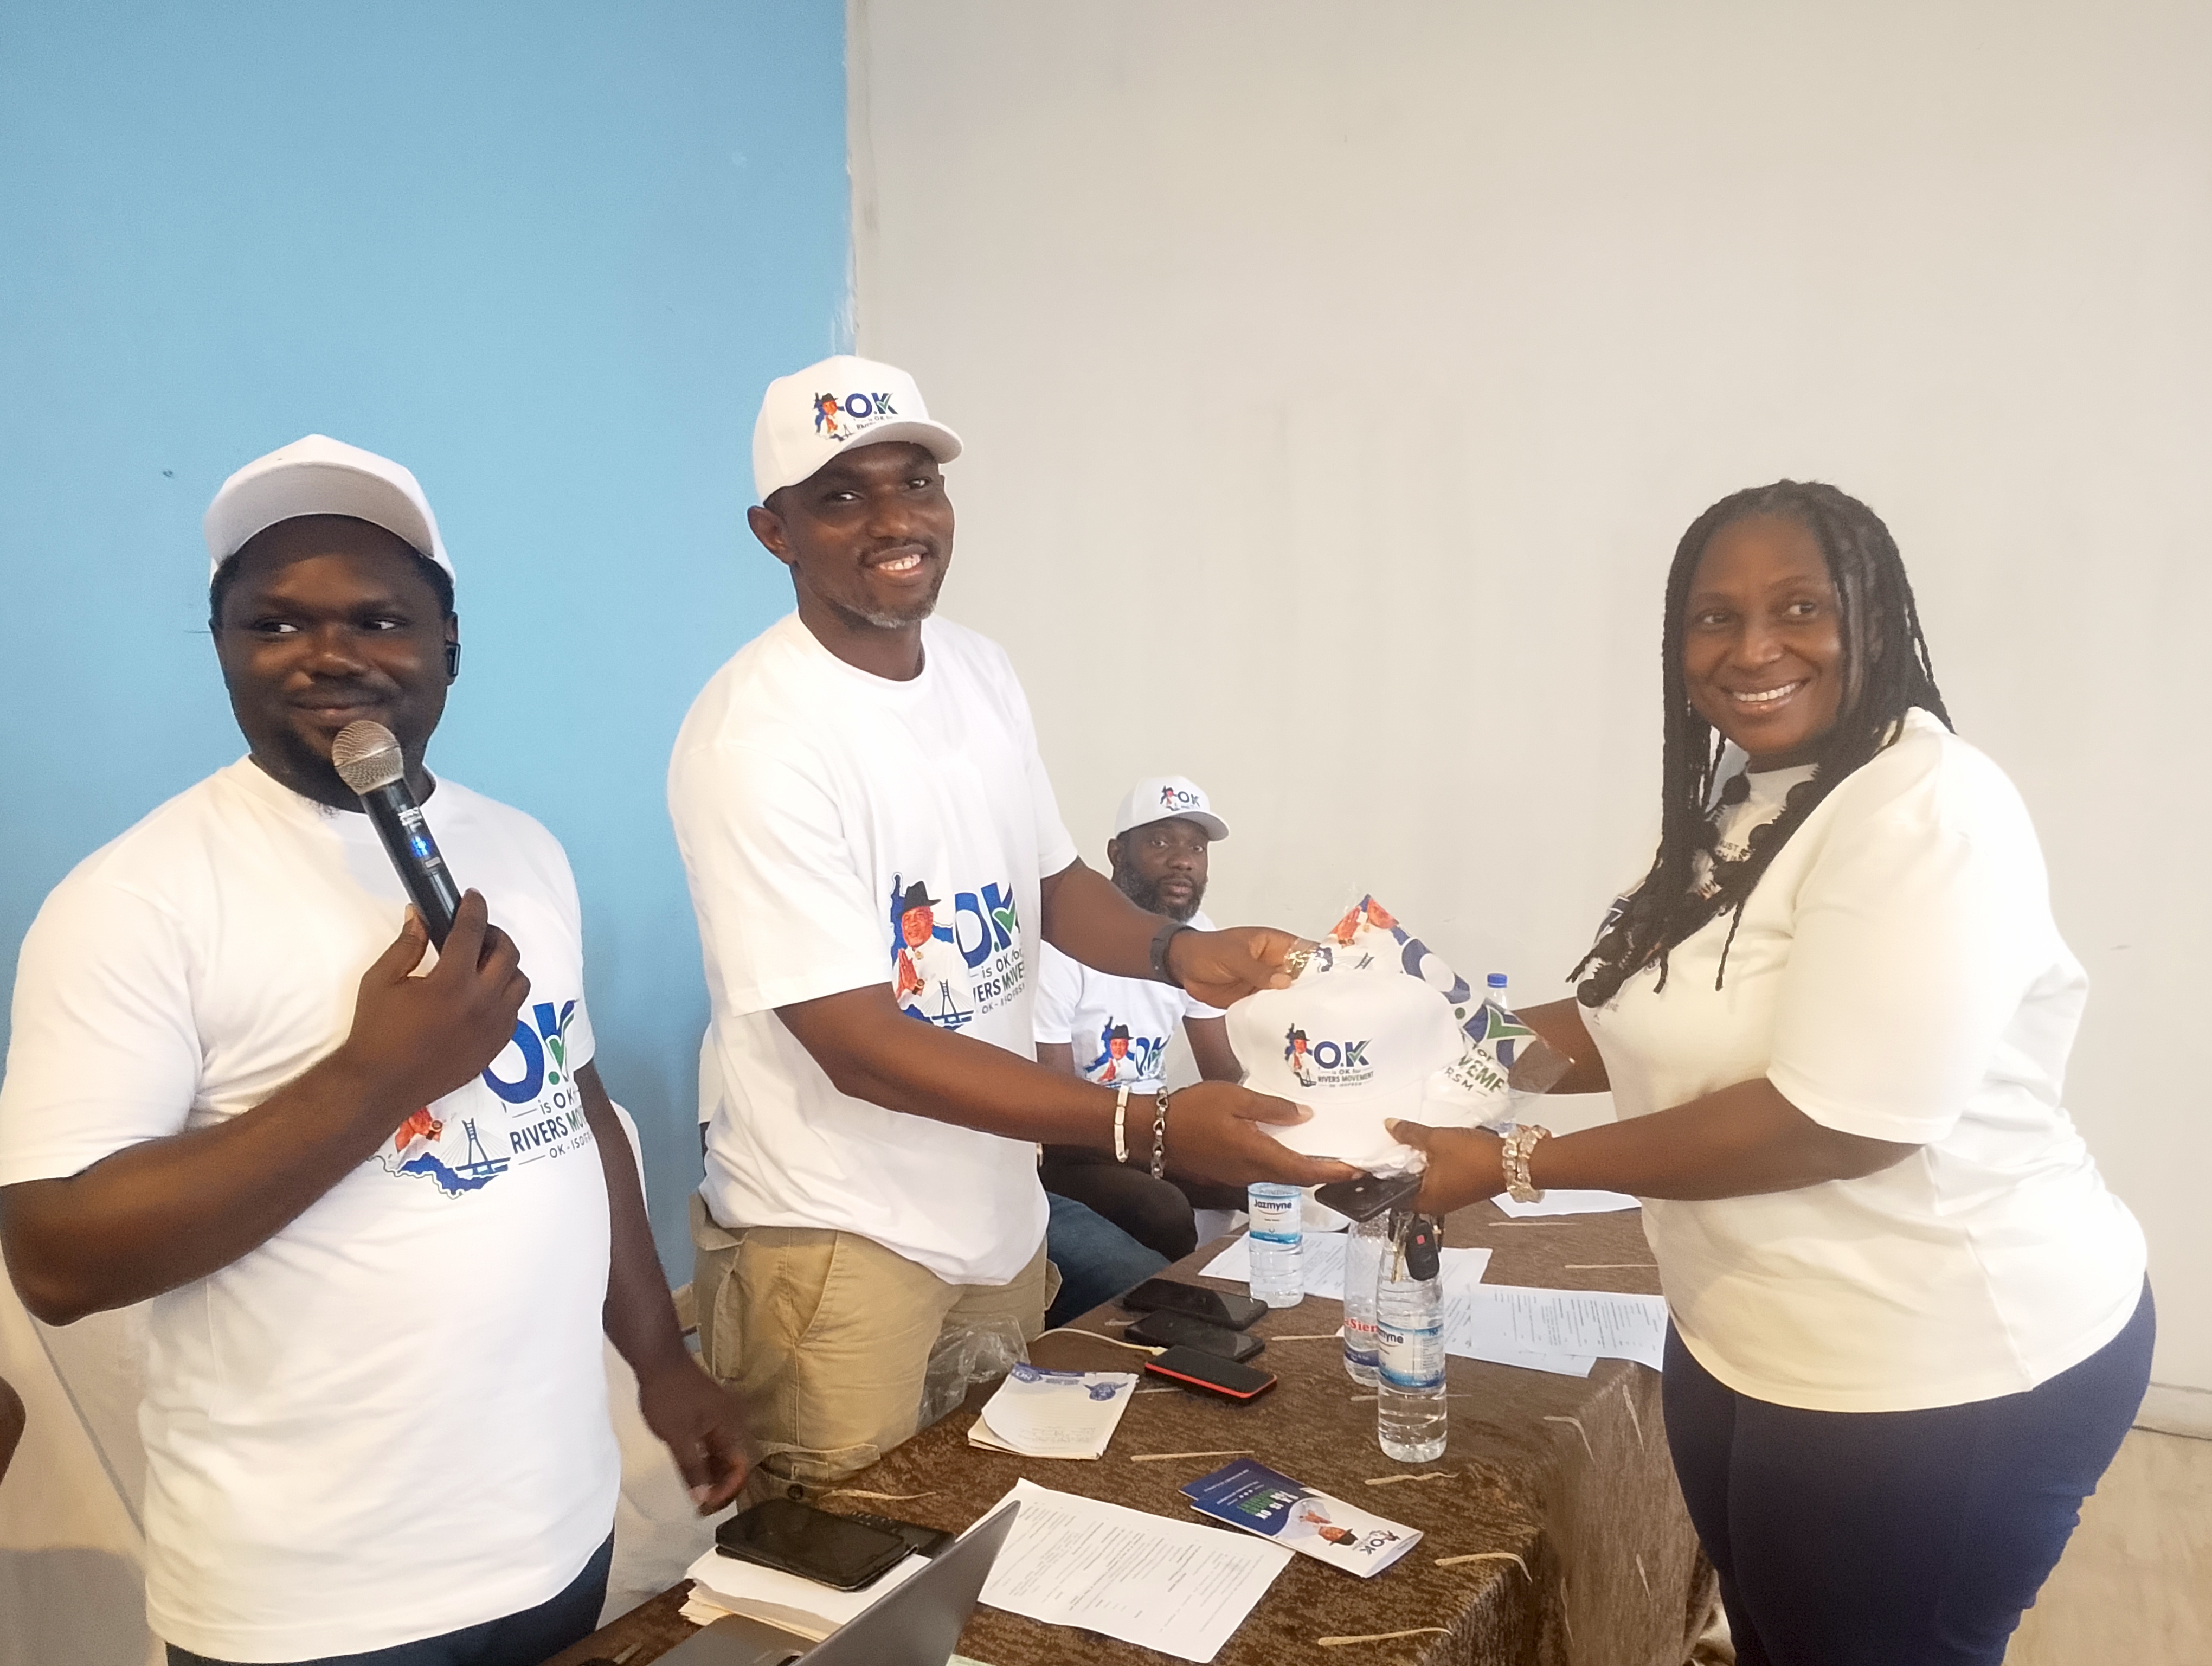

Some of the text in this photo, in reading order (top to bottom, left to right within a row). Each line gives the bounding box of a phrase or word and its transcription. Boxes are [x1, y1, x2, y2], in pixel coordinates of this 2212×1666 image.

[981, 966, 992, 978] is
[996, 953, 1011, 972] OK
[973, 978, 1001, 1004] ERS
[538, 1087, 575, 1115] is OK
[509, 1116, 568, 1154] RIVERS
[549, 1144, 566, 1158] OK
[1254, 1199, 1293, 1212] Jazmyne
